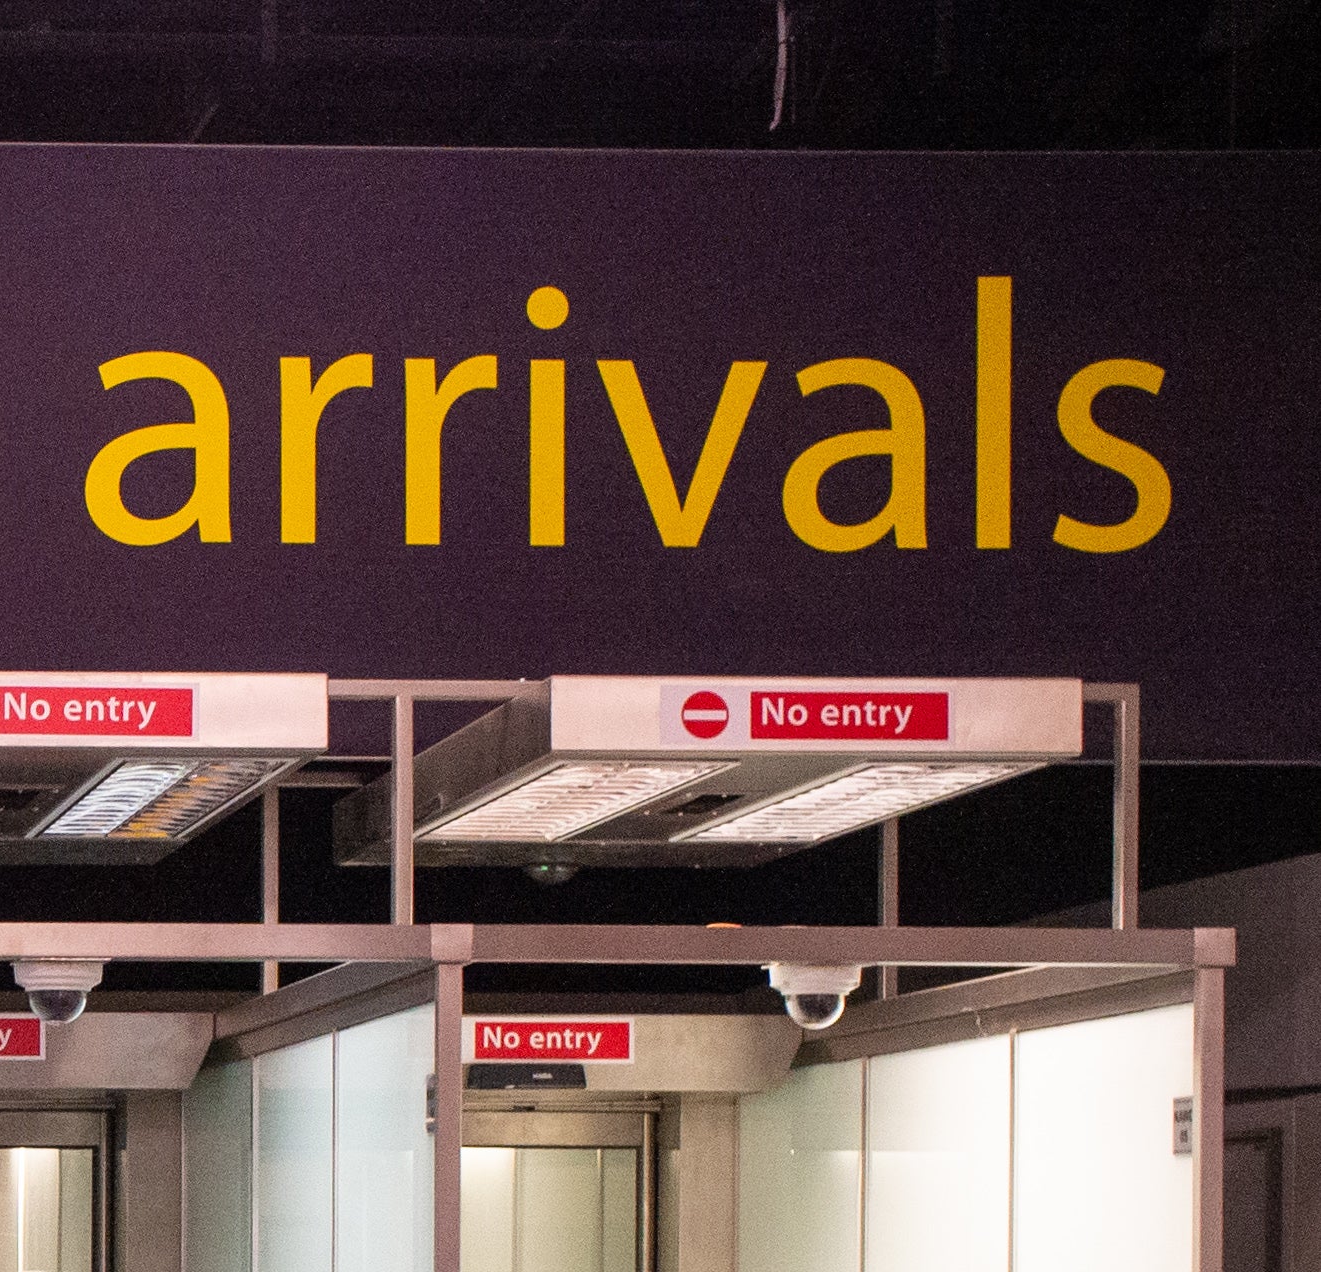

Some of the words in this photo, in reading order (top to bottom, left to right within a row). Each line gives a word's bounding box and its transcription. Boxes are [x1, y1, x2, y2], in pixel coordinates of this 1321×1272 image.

[84, 276, 1171, 555] arrivals
[4, 691, 51, 721] No
[63, 696, 157, 730] entry
[762, 697, 808, 726] No
[820, 701, 912, 734] entry
[483, 1026, 520, 1049] No
[529, 1029, 603, 1055] entry
